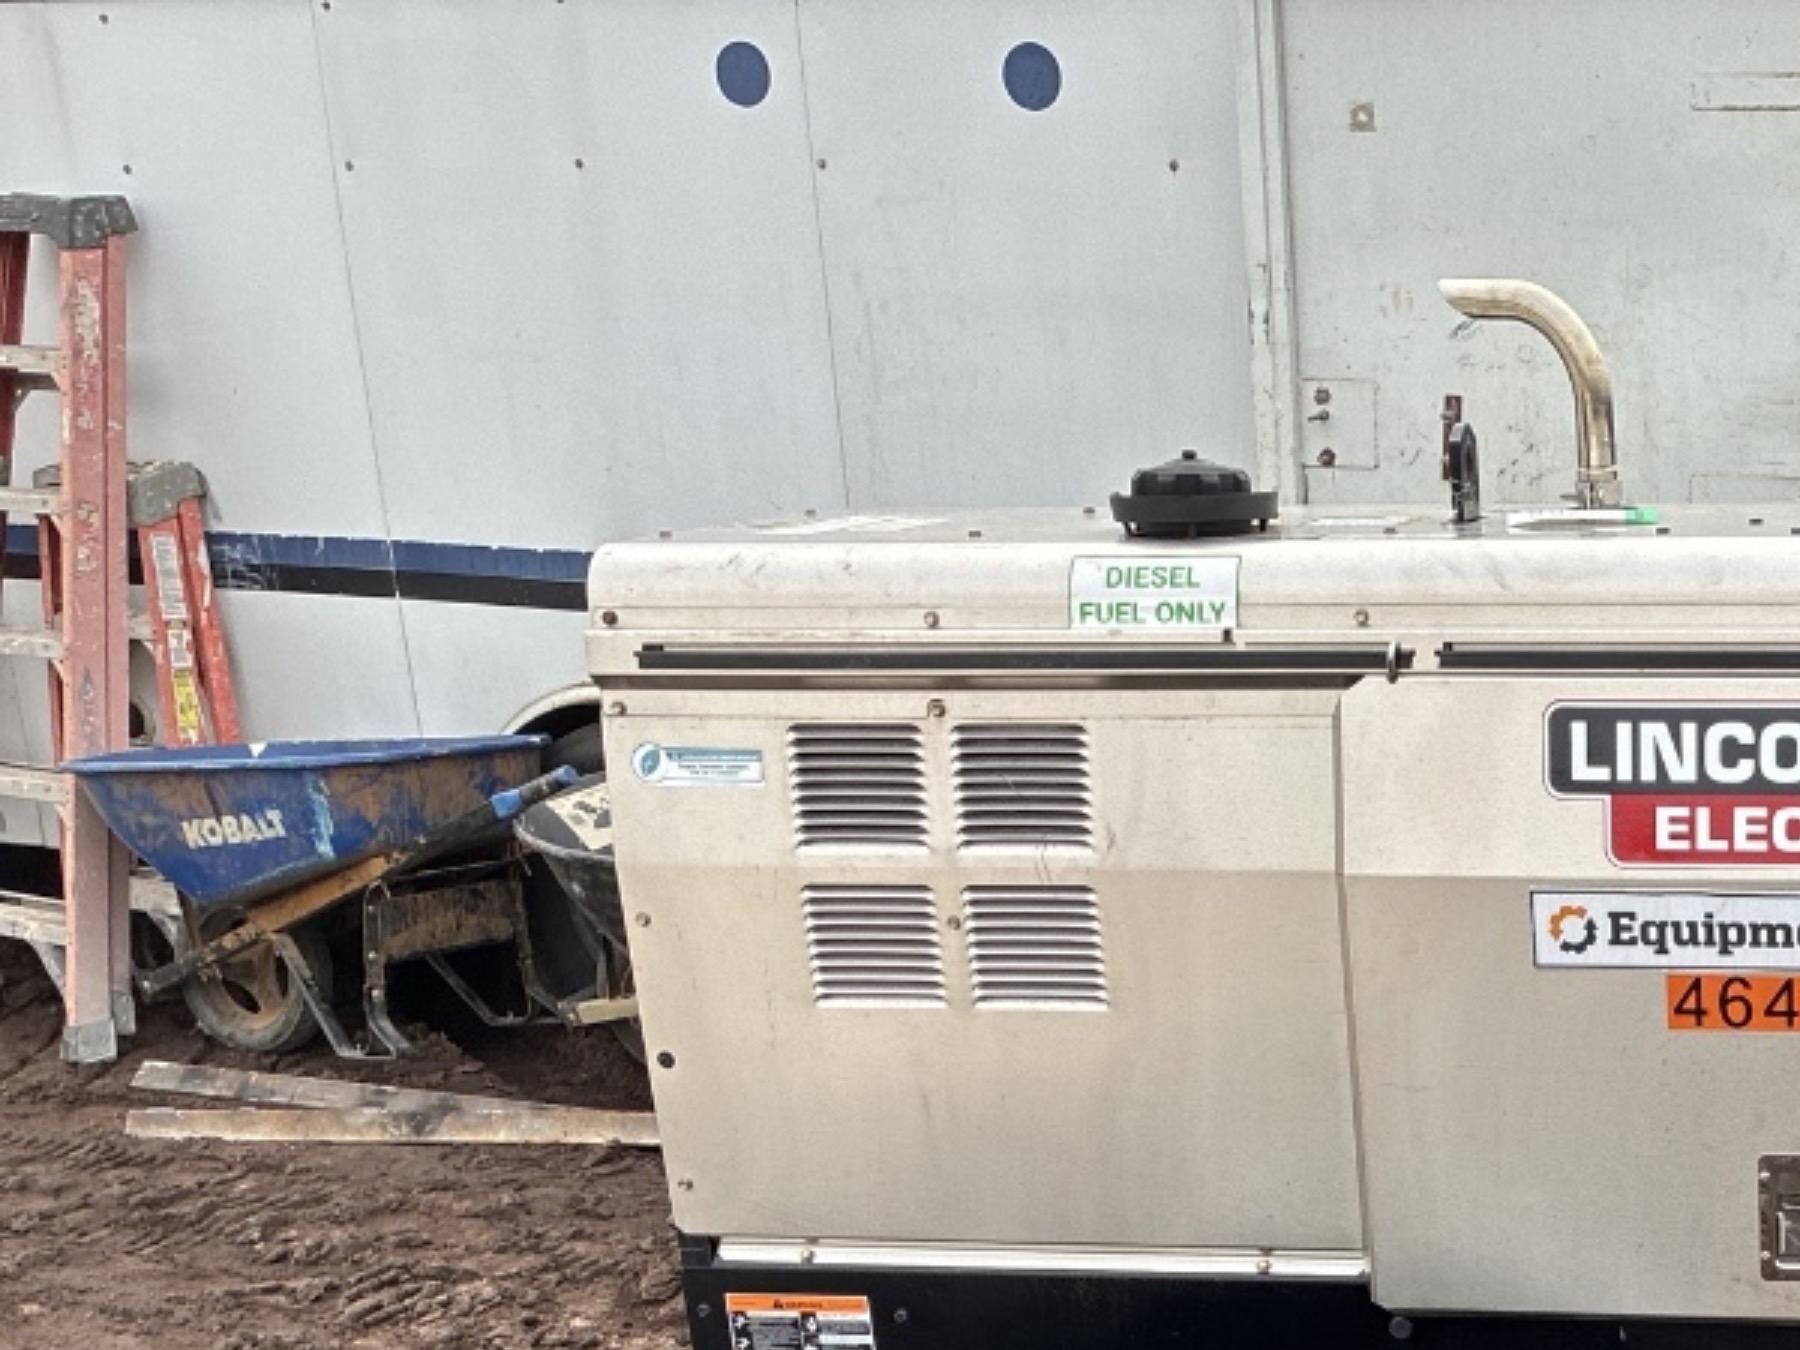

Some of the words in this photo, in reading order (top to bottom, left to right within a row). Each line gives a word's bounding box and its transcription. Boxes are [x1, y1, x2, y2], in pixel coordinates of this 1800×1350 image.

[1105, 566, 1201, 589] DIESEL
[1079, 601, 1146, 624] FUEL
[1154, 601, 1226, 624] ONLY
[180, 808, 288, 850] KOBALT
